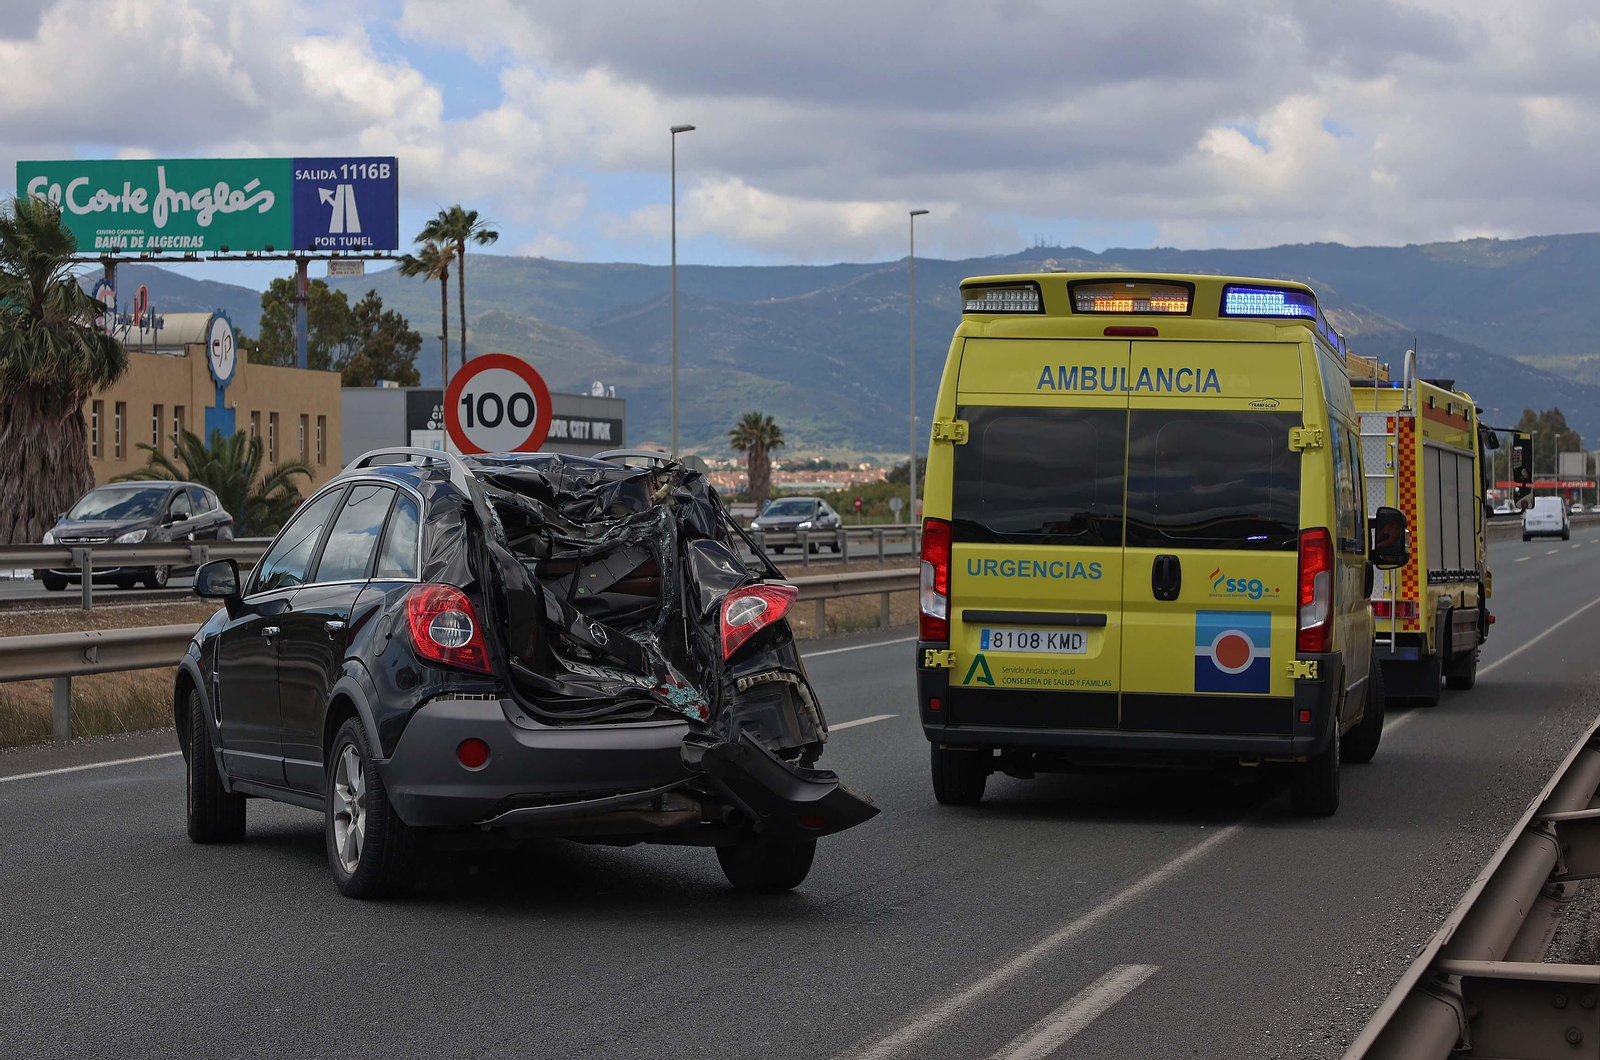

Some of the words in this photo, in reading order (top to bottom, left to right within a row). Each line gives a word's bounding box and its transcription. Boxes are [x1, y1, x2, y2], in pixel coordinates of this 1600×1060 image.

[295, 170, 337, 180] SALIDA
[340, 163, 390, 179] 1116B
[65, 176, 149, 215] Corte
[153, 165, 275, 228] Inglés
[95, 234, 127, 248] BAHÍA
[130, 236, 145, 248] DE
[146, 235, 204, 248] ALGECIRAS
[314, 237, 336, 246] POR
[339, 236, 373, 246] TUNEL
[1036, 365, 1222, 394] AMBULANCIA
[461, 392, 535, 428] 100
[547, 419, 568, 438] DOR
[569, 420, 590, 439] CITY
[591, 421, 611, 441] WOK
[967, 558, 1103, 580] URGENCIAS
[993, 632, 1040, 649] 8108
[1047, 633, 1082, 650] KMD
[1002, 666, 1024, 674] Servicio
[1025, 666, 1049, 675] Andaluz
[1051, 667, 1059, 675] de
[1002, 676, 1042, 685] CONSEJERÍA
[1053, 678, 1075, 686] SALUD
[1082, 679, 1112, 687] FAMILIAS
